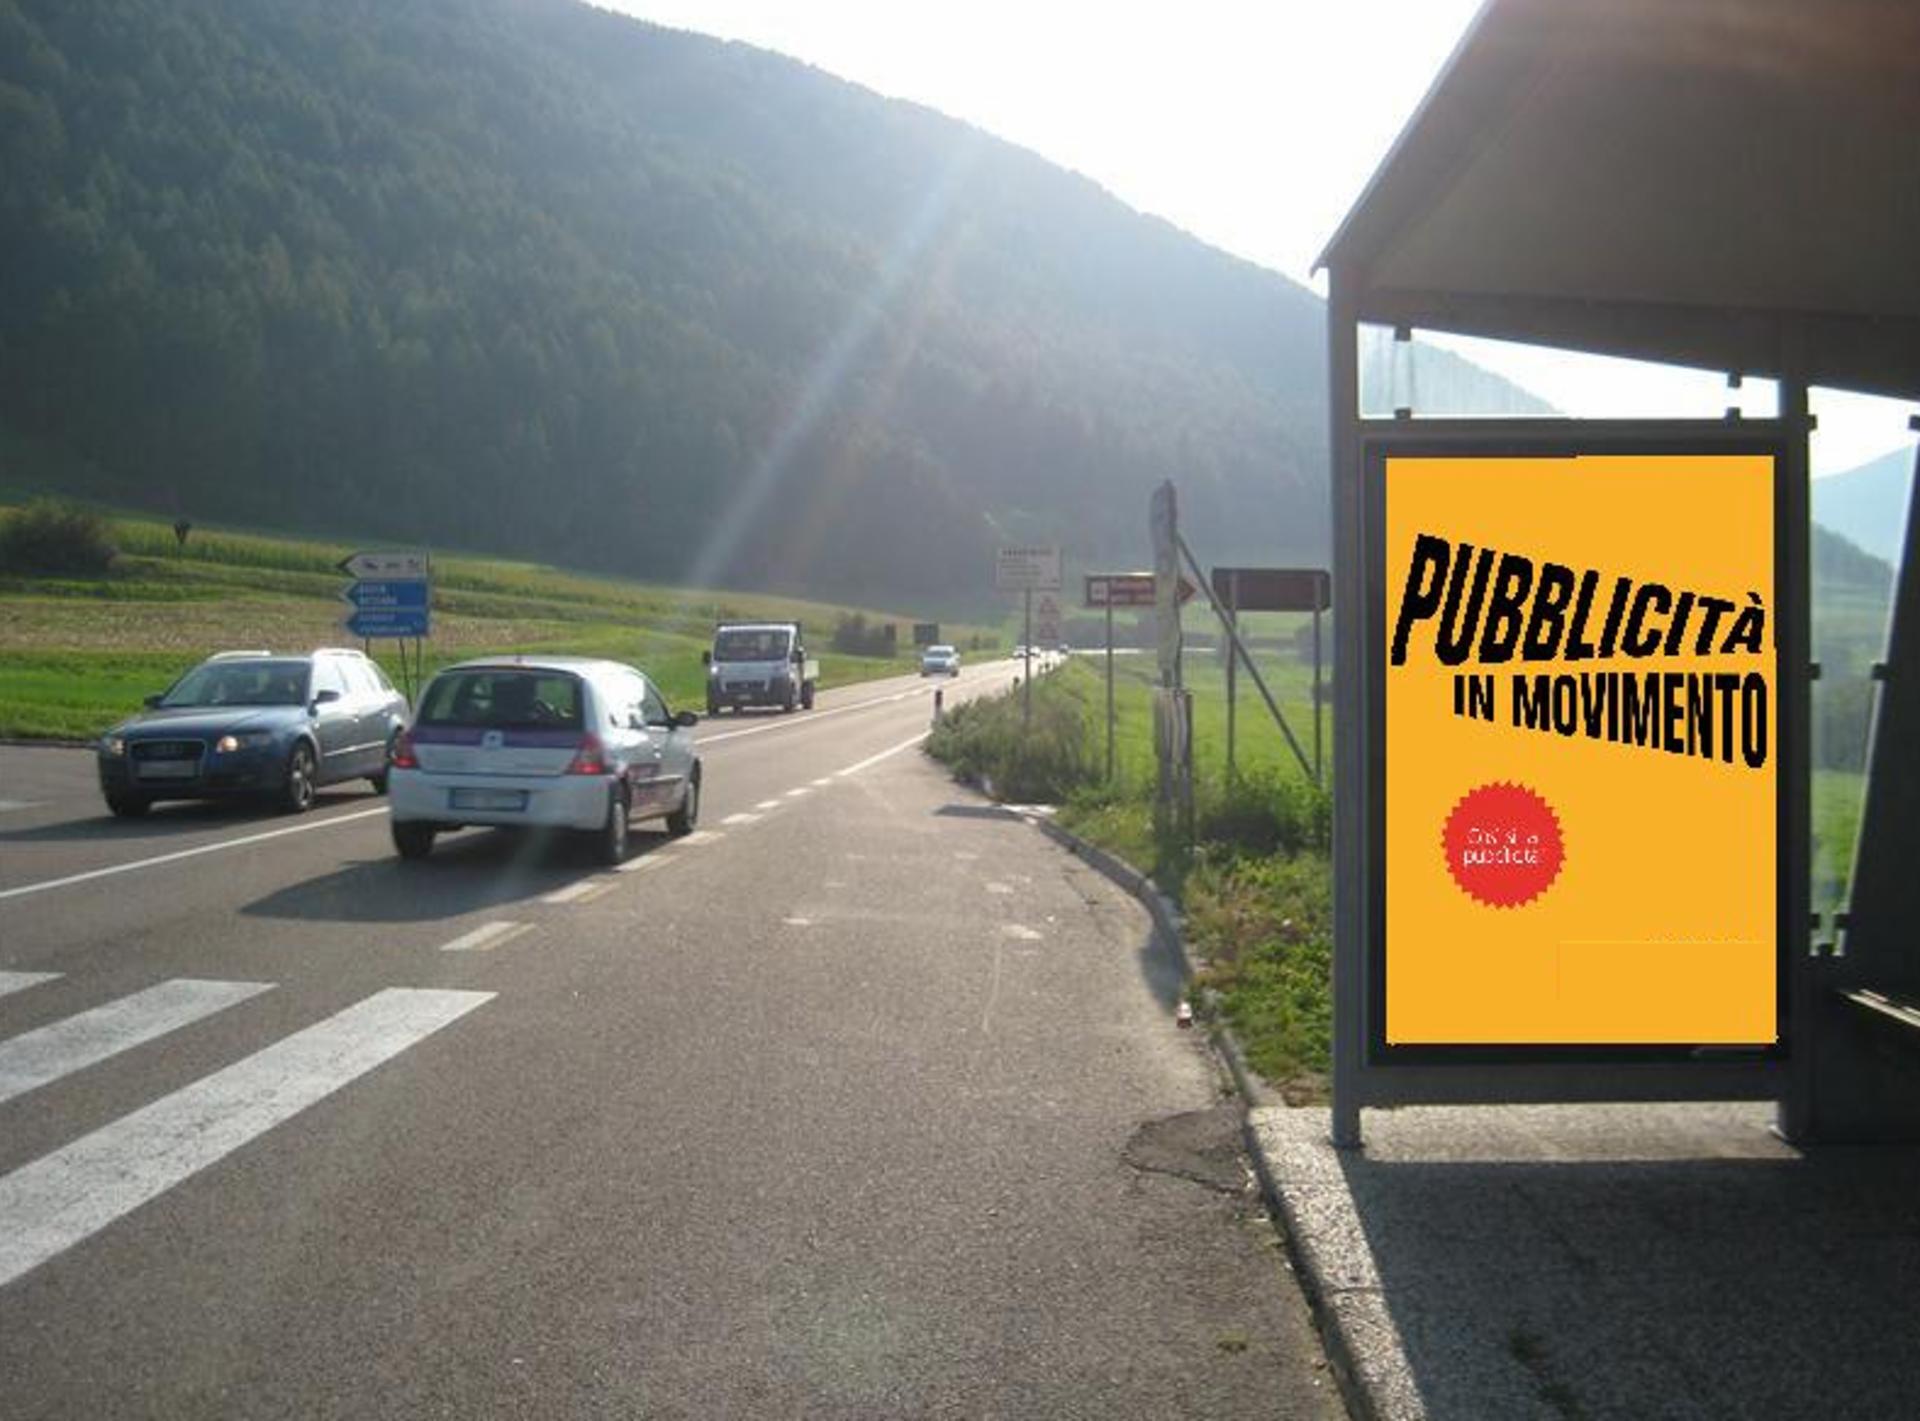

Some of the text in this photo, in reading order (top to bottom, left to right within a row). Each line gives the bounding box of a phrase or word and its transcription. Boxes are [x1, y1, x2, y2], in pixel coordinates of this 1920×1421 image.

[1391, 533, 1765, 666] PUBBLICITÀ
[1454, 672, 1767, 769] IN MOVIMENTO
